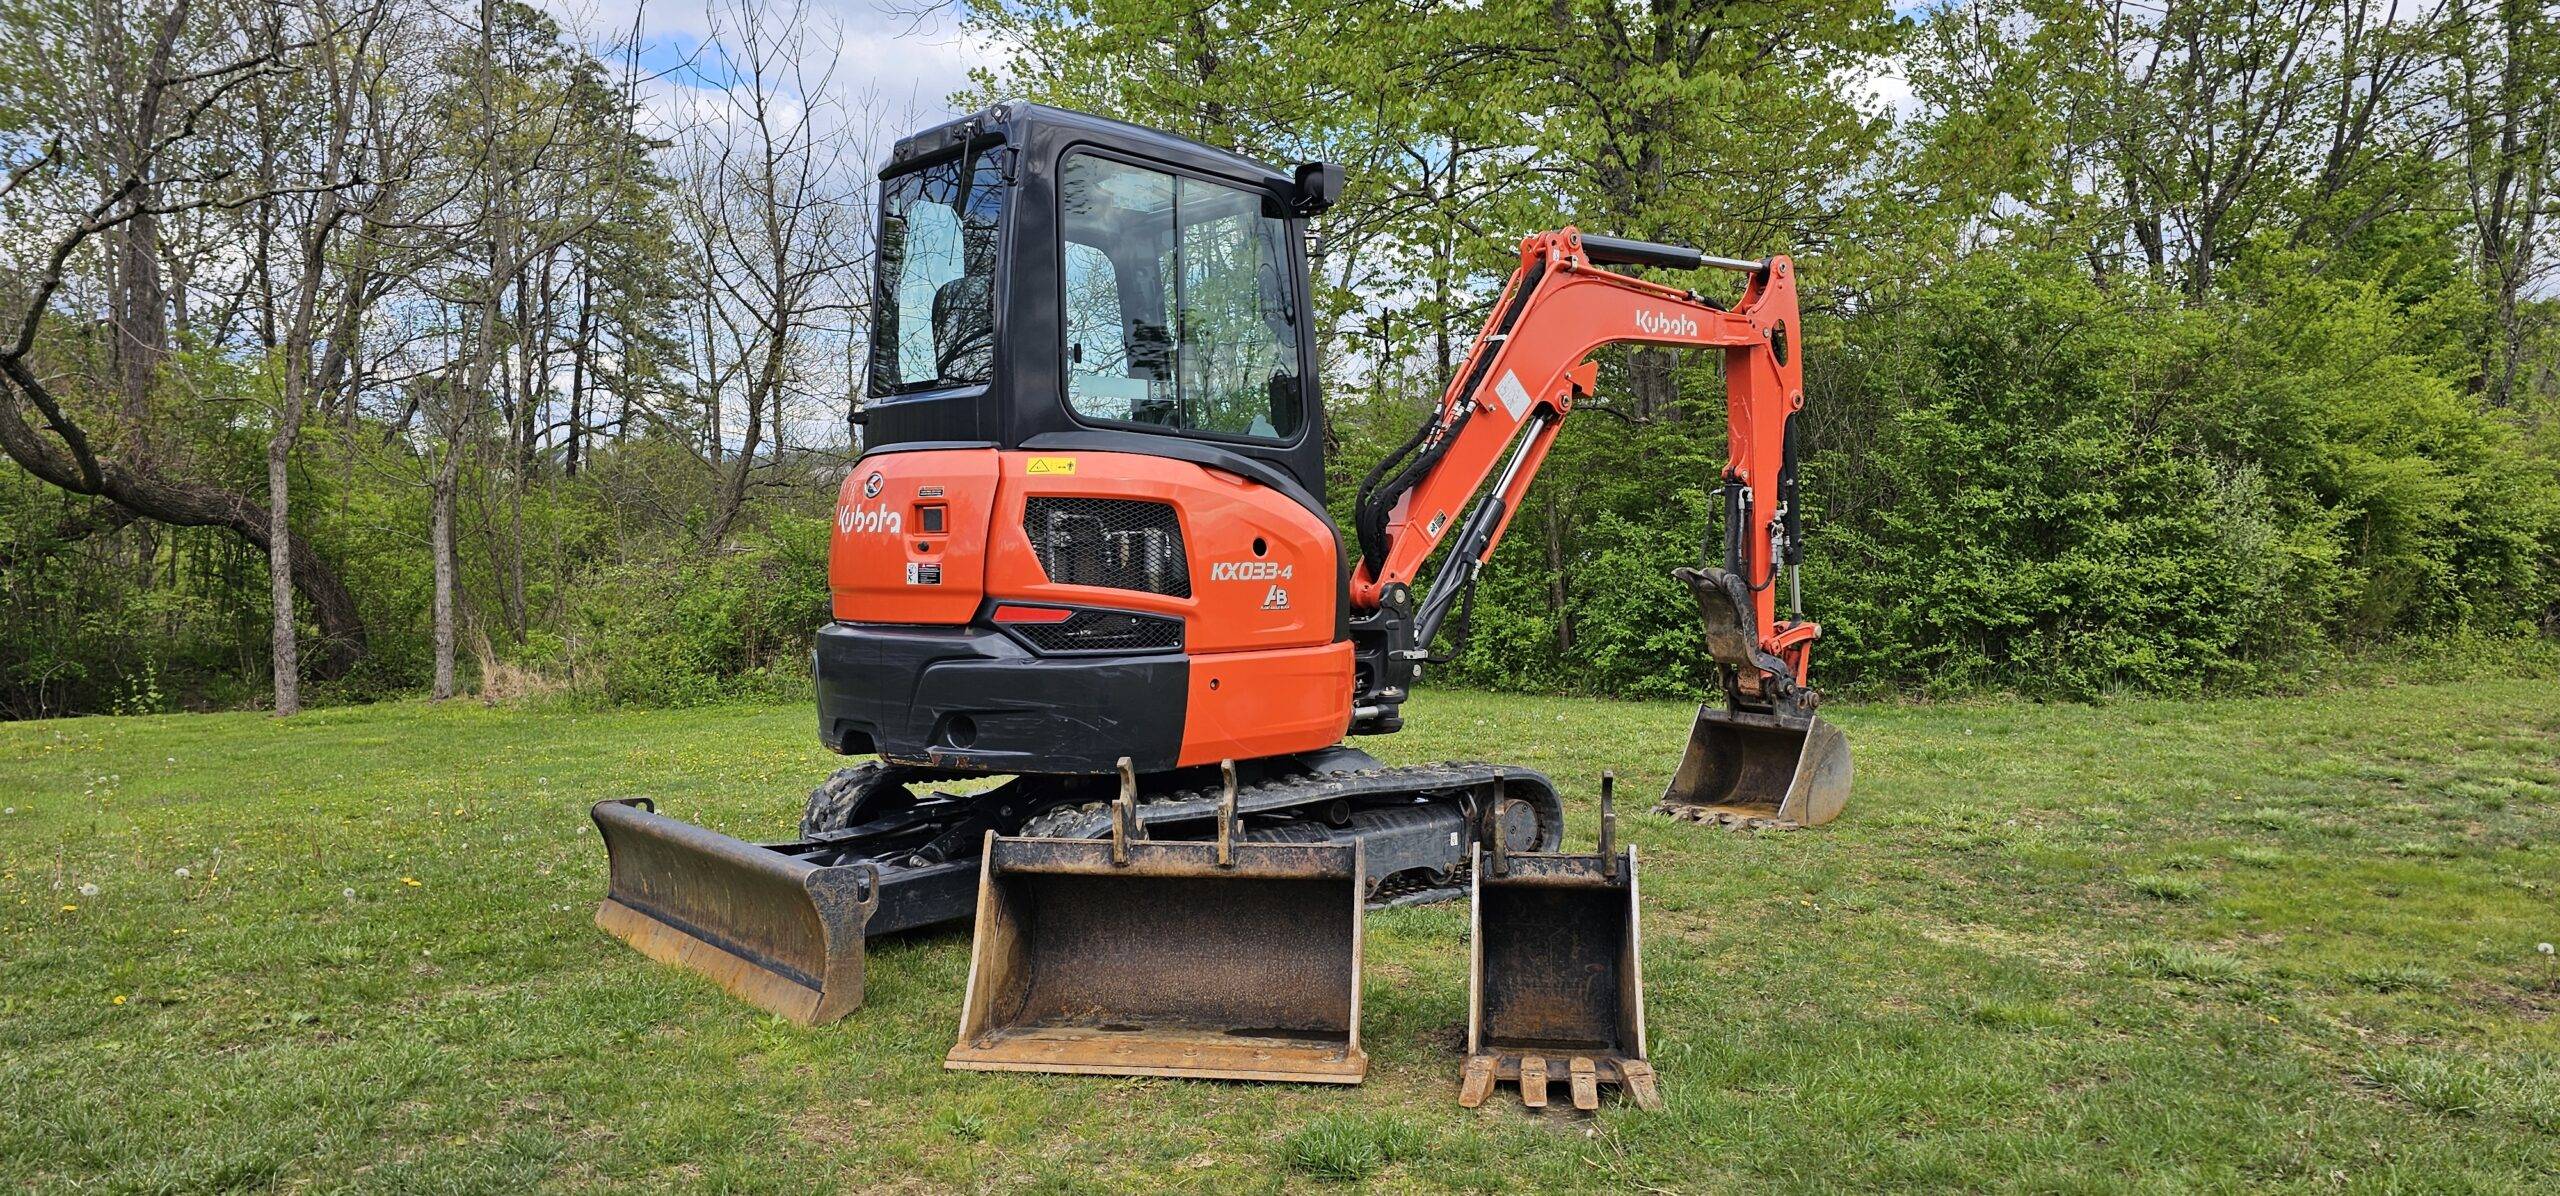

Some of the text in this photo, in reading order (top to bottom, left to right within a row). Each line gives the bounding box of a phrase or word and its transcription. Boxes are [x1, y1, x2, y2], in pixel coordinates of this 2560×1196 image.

[1636, 309, 1698, 337] Kubota
[838, 503, 901, 533] Kubota
[1211, 562, 1293, 581] KX033-4
